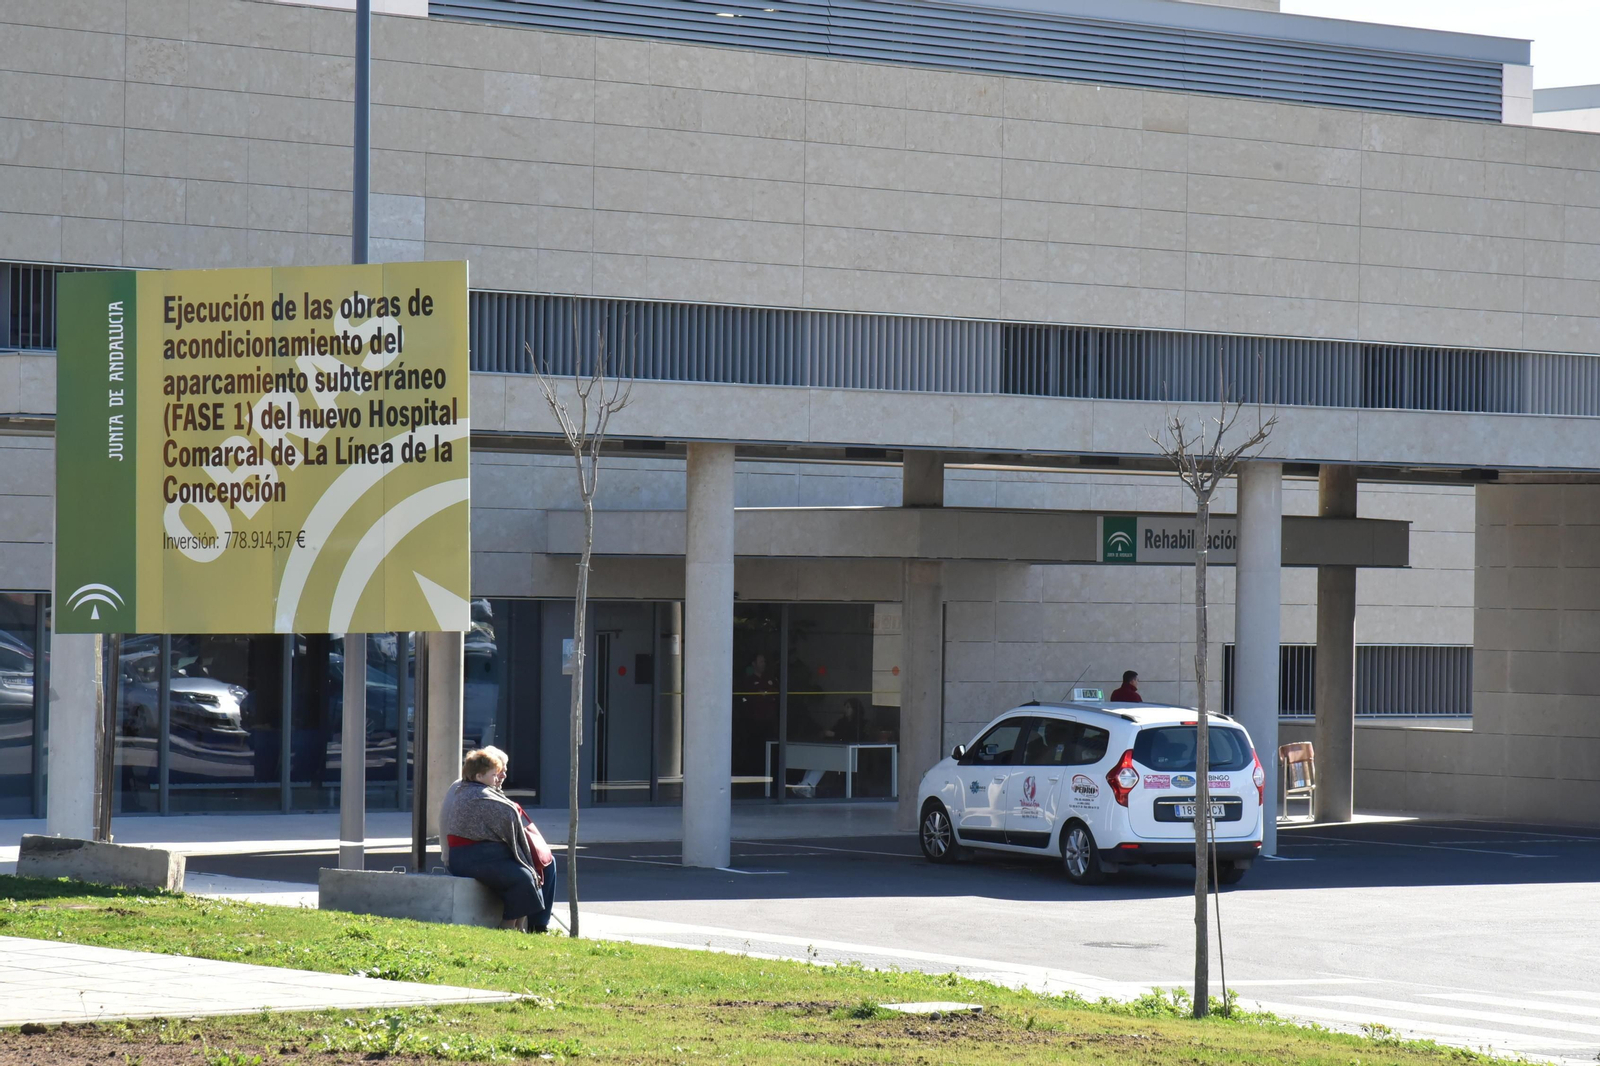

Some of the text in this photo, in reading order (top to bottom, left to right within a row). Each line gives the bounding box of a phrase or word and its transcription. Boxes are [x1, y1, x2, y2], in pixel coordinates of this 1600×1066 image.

[163, 288, 434, 330] Ejecución de las obras de
[163, 325, 403, 360] acondicionamiento del
[108, 301, 124, 462] JUNTA DE ANDALUCIA
[163, 362, 446, 402] aparcamiento subterráneo
[163, 295, 404, 563] OBRAS
[164, 397, 458, 437] (FASE 1) del nuevo Hospital
[163, 434, 453, 468] Comarcal de La Línea de la
[163, 474, 287, 509] Concepción
[163, 530, 306, 551] Inversión: 778.914,57 €
[1144, 528, 1238, 550] Rehabilación
[1083, 689, 1098, 699] TAXI
